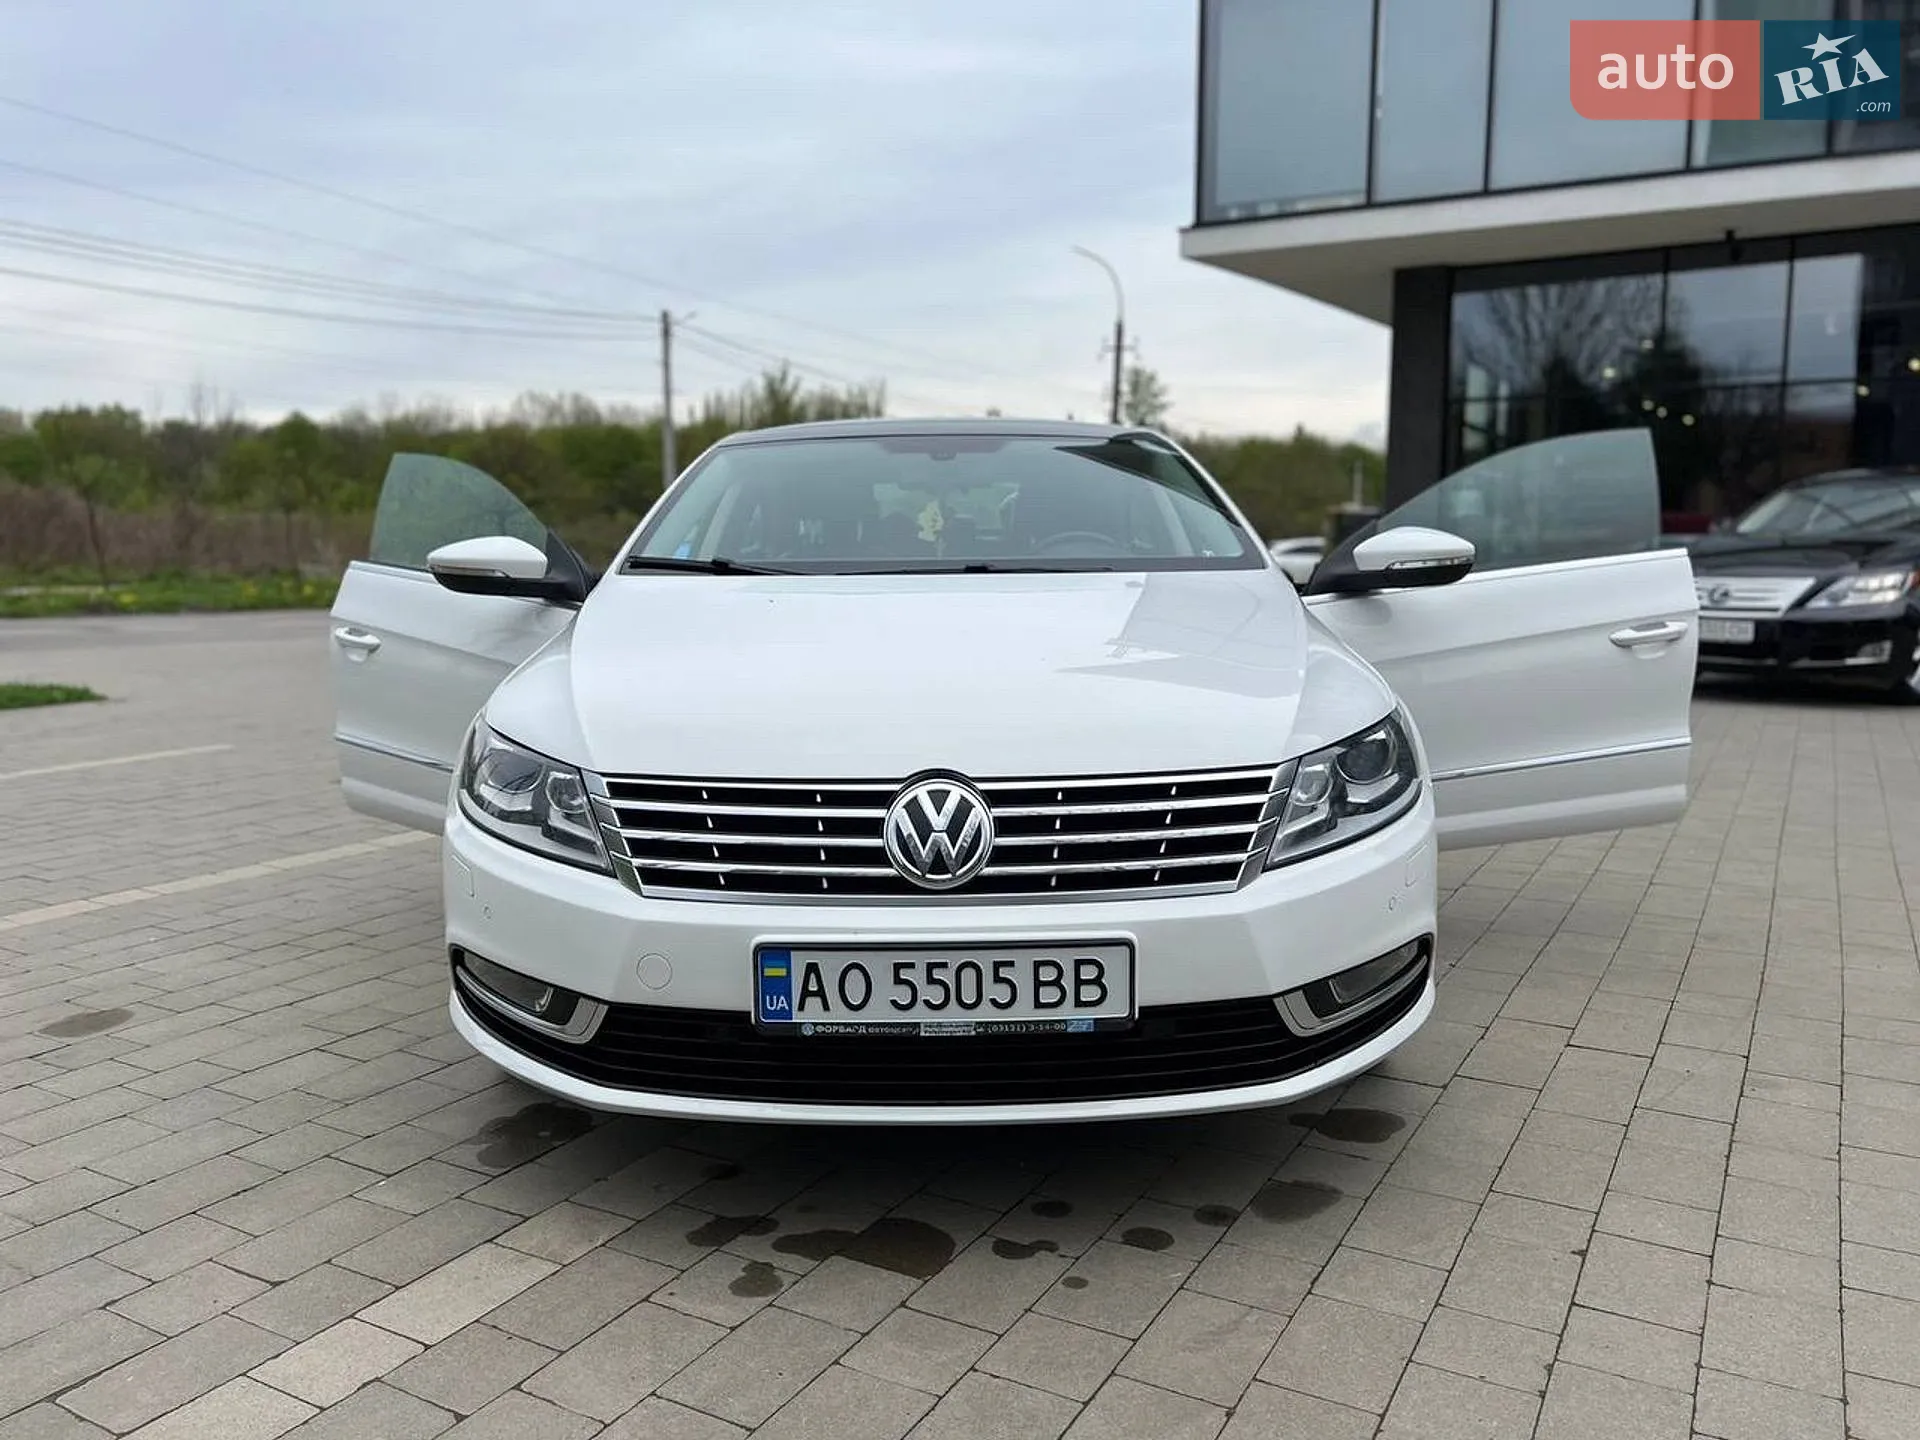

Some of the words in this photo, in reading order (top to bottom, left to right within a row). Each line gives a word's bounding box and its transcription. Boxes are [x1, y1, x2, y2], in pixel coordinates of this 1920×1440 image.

[797, 961, 873, 1012] AO
[889, 959, 1018, 1011] 5505
[1033, 957, 1108, 1010] BB
[766, 995, 789, 1011] UA
